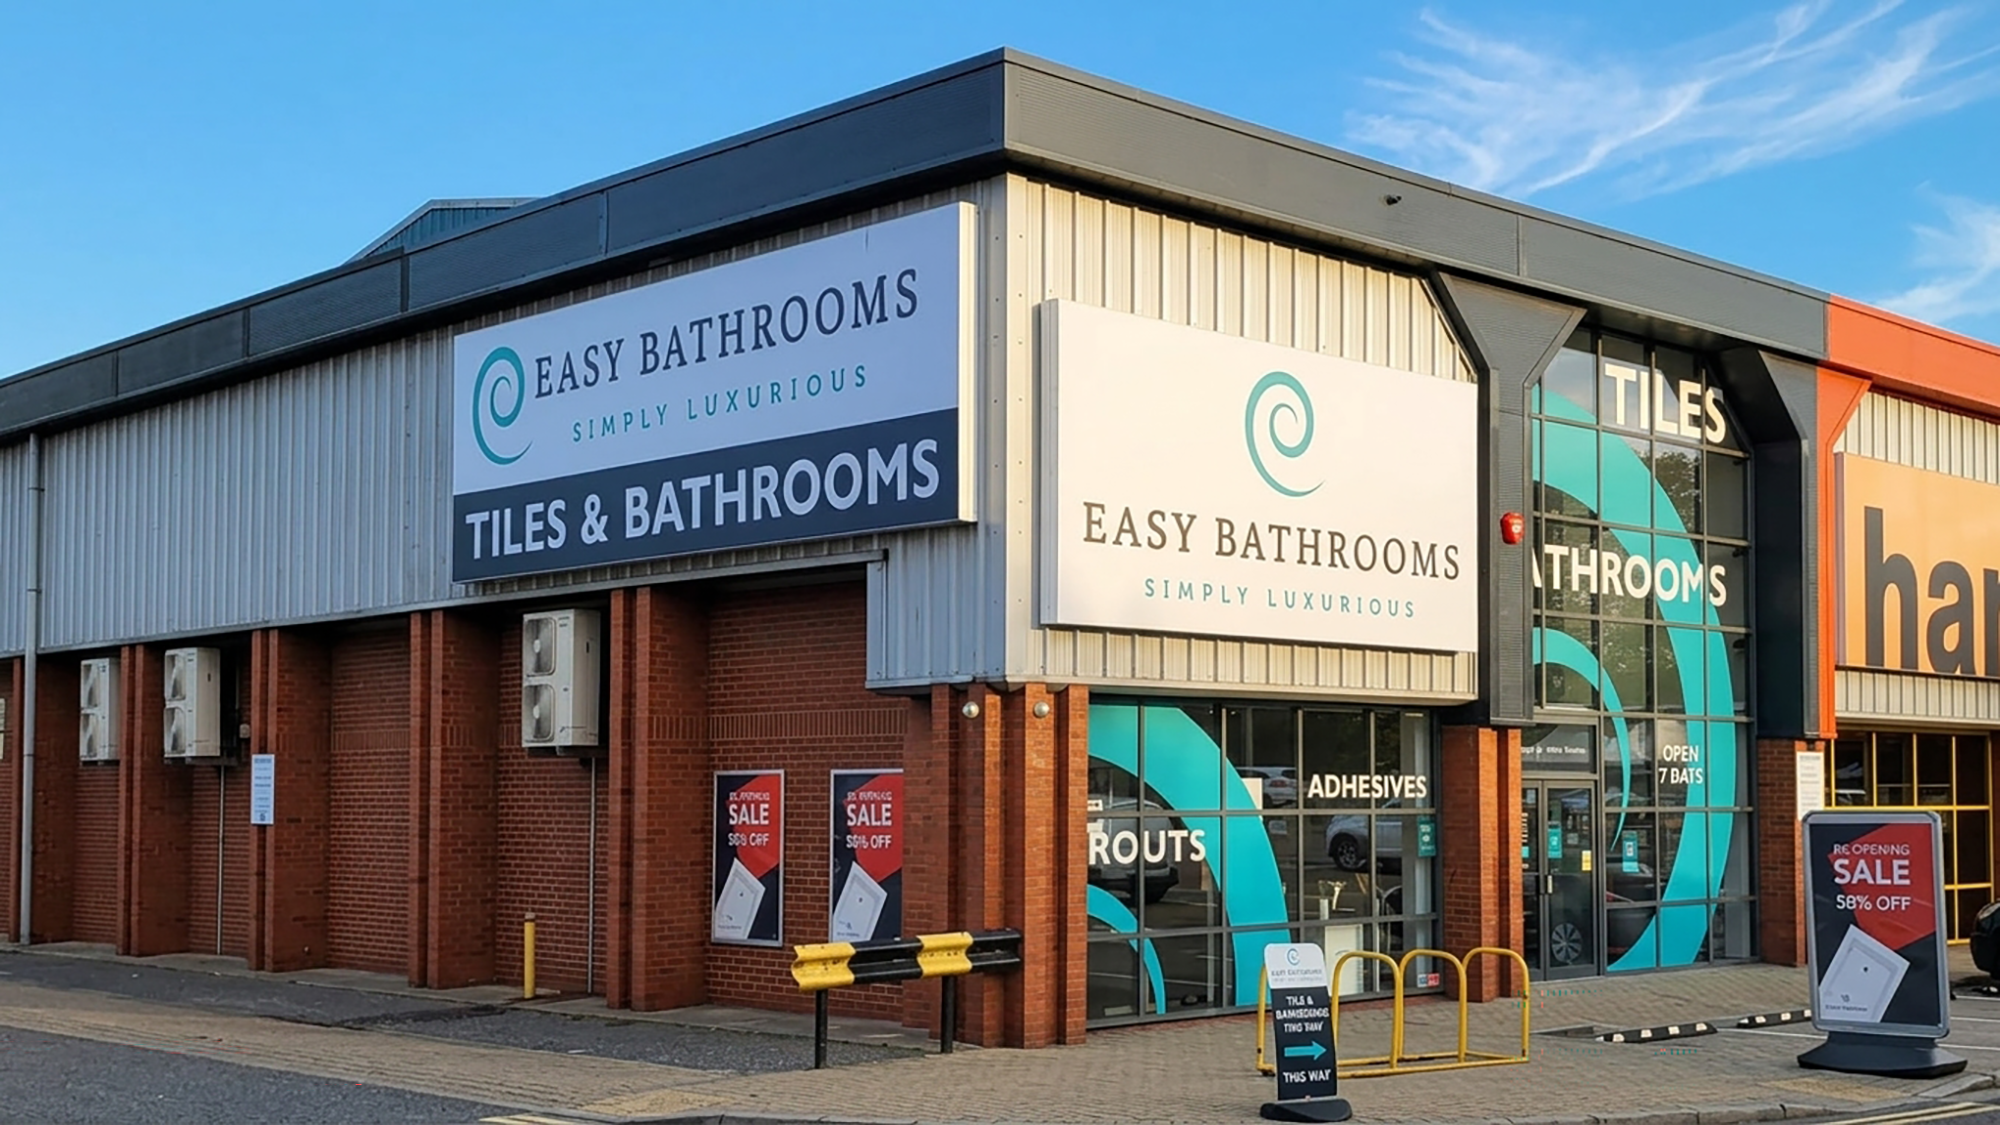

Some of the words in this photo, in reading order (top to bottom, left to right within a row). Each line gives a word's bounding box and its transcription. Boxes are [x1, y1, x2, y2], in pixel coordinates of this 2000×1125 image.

[535, 338, 625, 399] EASY
[639, 268, 919, 376] BATHROOMS
[572, 403, 669, 442] SIMPLY
[687, 365, 867, 420] LUXURIOUS
[1604, 361, 1727, 444] TILES
[465, 499, 567, 560] TILES
[580, 493, 609, 545] &
[624, 438, 940, 540] BATHROOMS
[1082, 500, 1198, 553] EASY
[1214, 517, 1460, 581] BATHROOMS
[1144, 578, 1249, 605] SIMPLY
[1267, 588, 1415, 618] LUXURIOUS
[1662, 744, 1699, 762] OPEN
[1307, 773, 1427, 800] ADHESIVES
[1658, 767, 1668, 784] 7
[1670, 767, 1704, 784] BATS
[729, 803, 770, 825] SALE
[846, 803, 892, 827] SALE
[870, 834, 892, 849] OFF
[1088, 829, 1206, 866] ROUTS
[1851, 843, 1911, 856] OPENING
[1833, 858, 1911, 886] SALE
[1876, 895, 1912, 911] OFF
[1282, 1070, 1307, 1083] THIS
[1308, 1068, 1332, 1082] WAY
